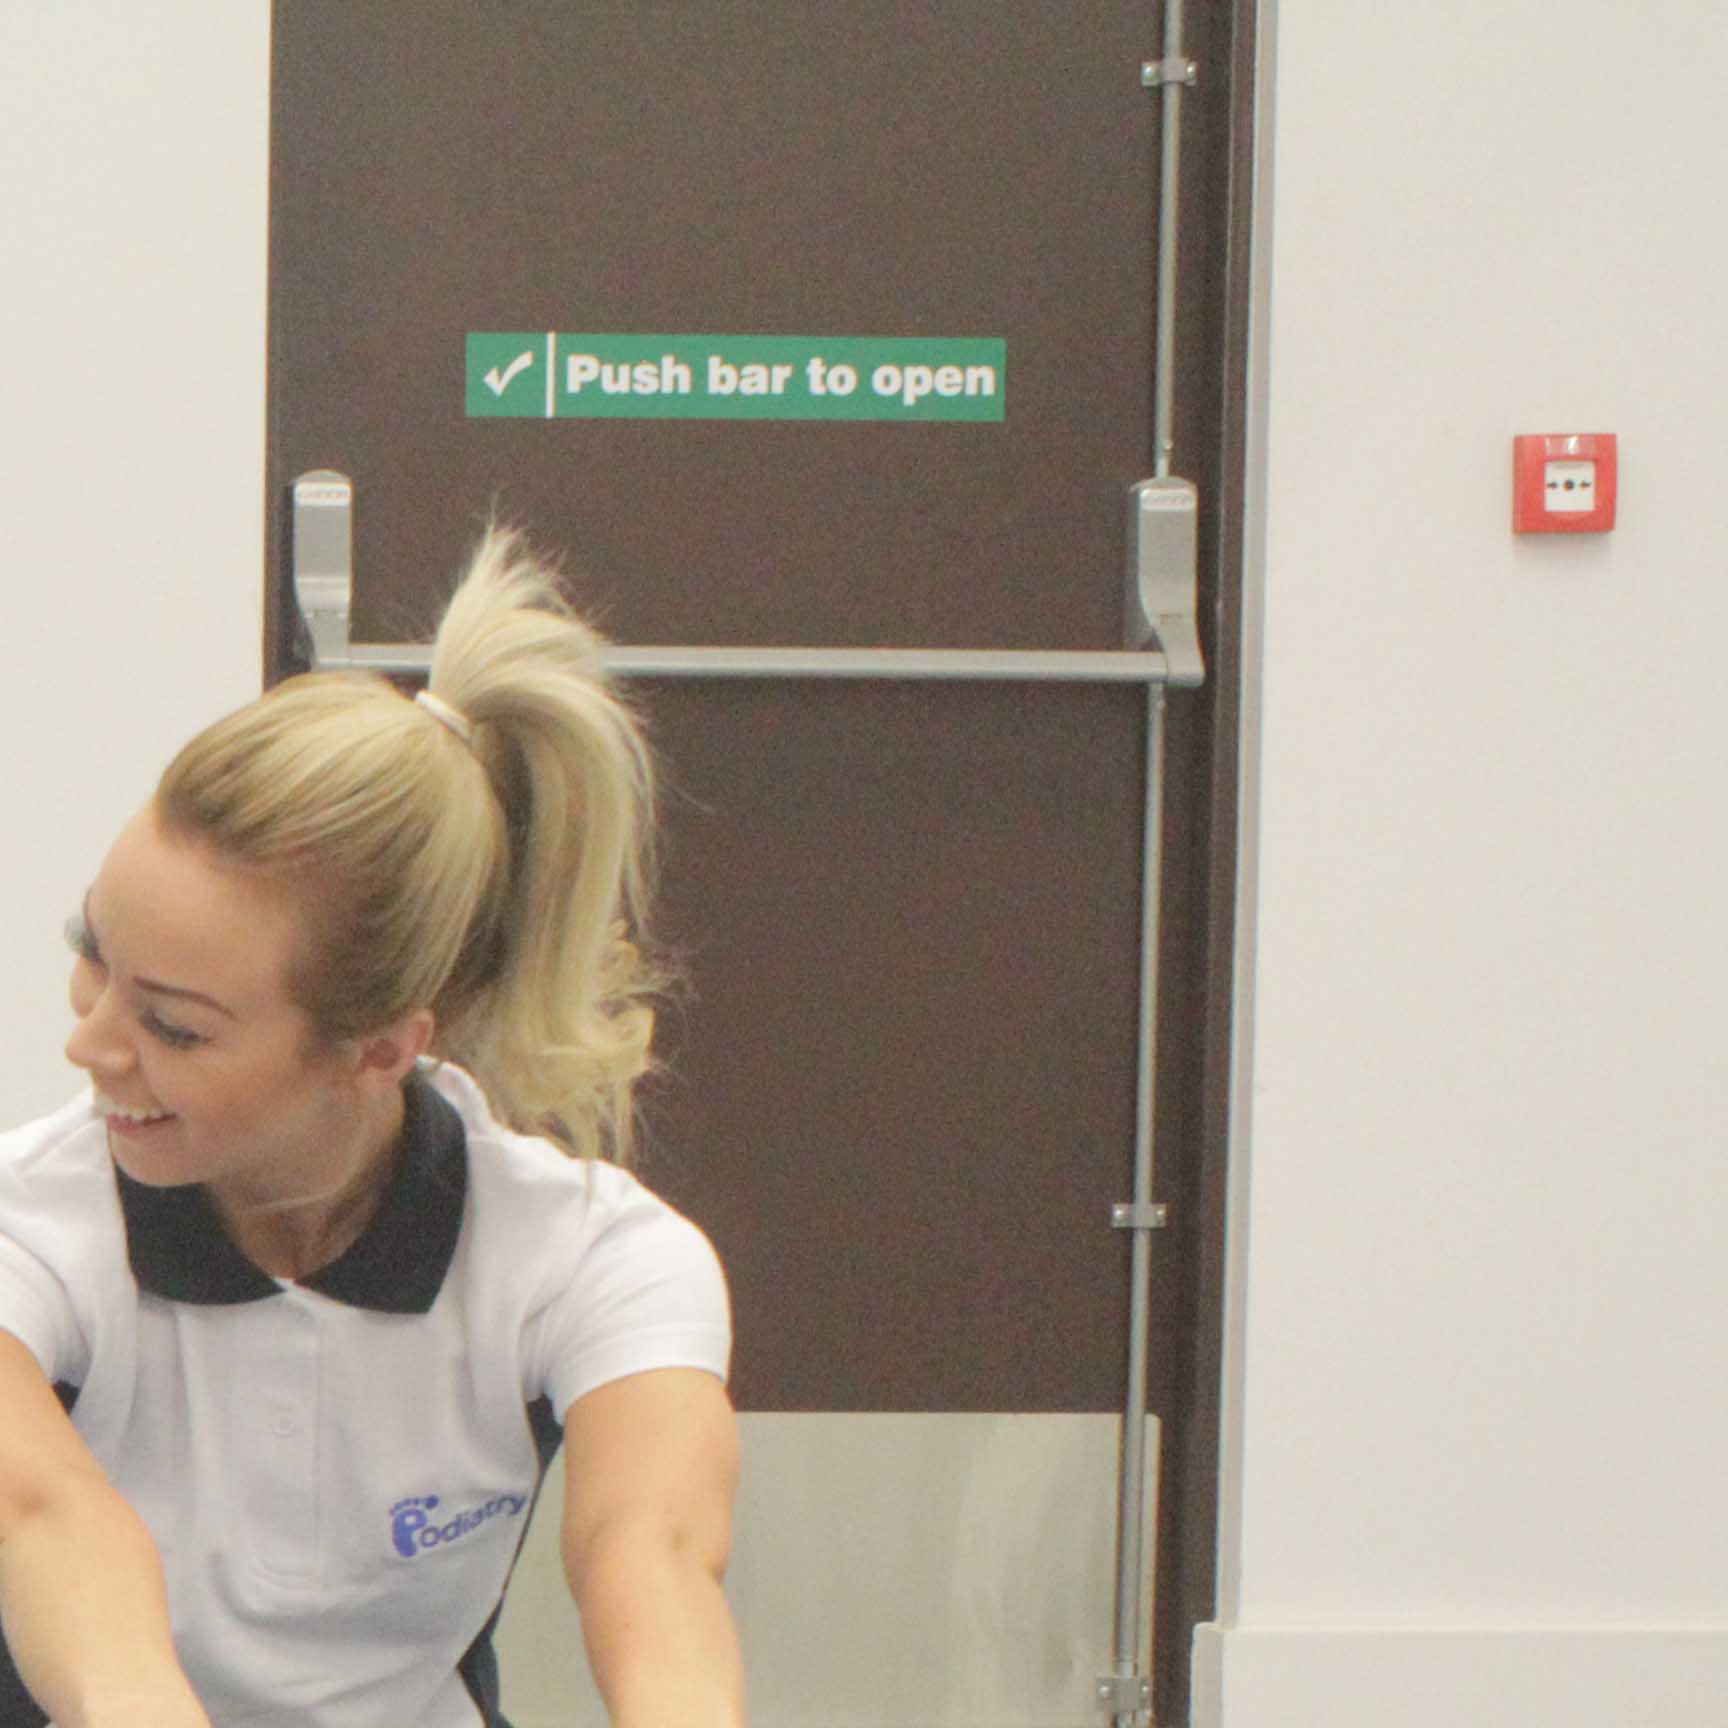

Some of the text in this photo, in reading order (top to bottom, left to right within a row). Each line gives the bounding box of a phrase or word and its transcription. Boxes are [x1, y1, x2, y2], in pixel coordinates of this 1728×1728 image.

[566, 354, 996, 405] Push bar to open
[390, 1494, 528, 1557] Podiatry
